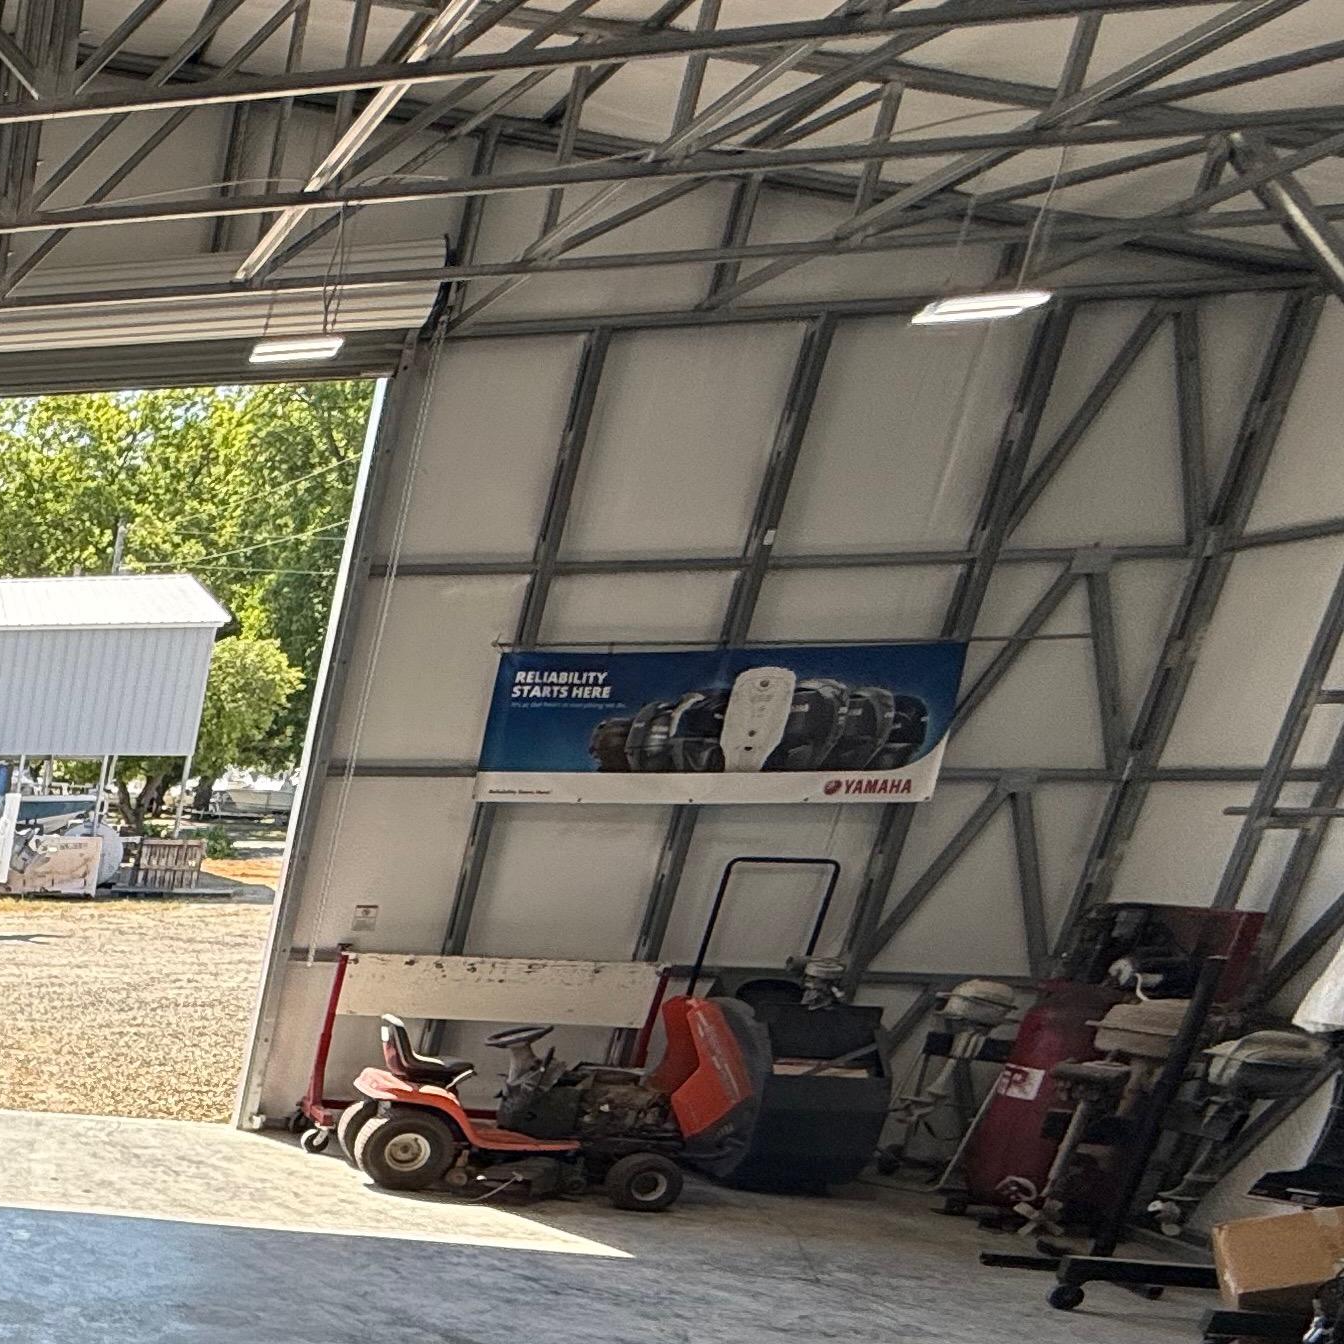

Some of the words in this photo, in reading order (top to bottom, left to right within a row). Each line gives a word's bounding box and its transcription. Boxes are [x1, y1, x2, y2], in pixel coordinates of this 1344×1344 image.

[514, 671, 608, 684] RELIABILITY
[512, 685, 569, 698] STARTS
[571, 686, 611, 698] HERE
[844, 779, 912, 794] YAMAHA
